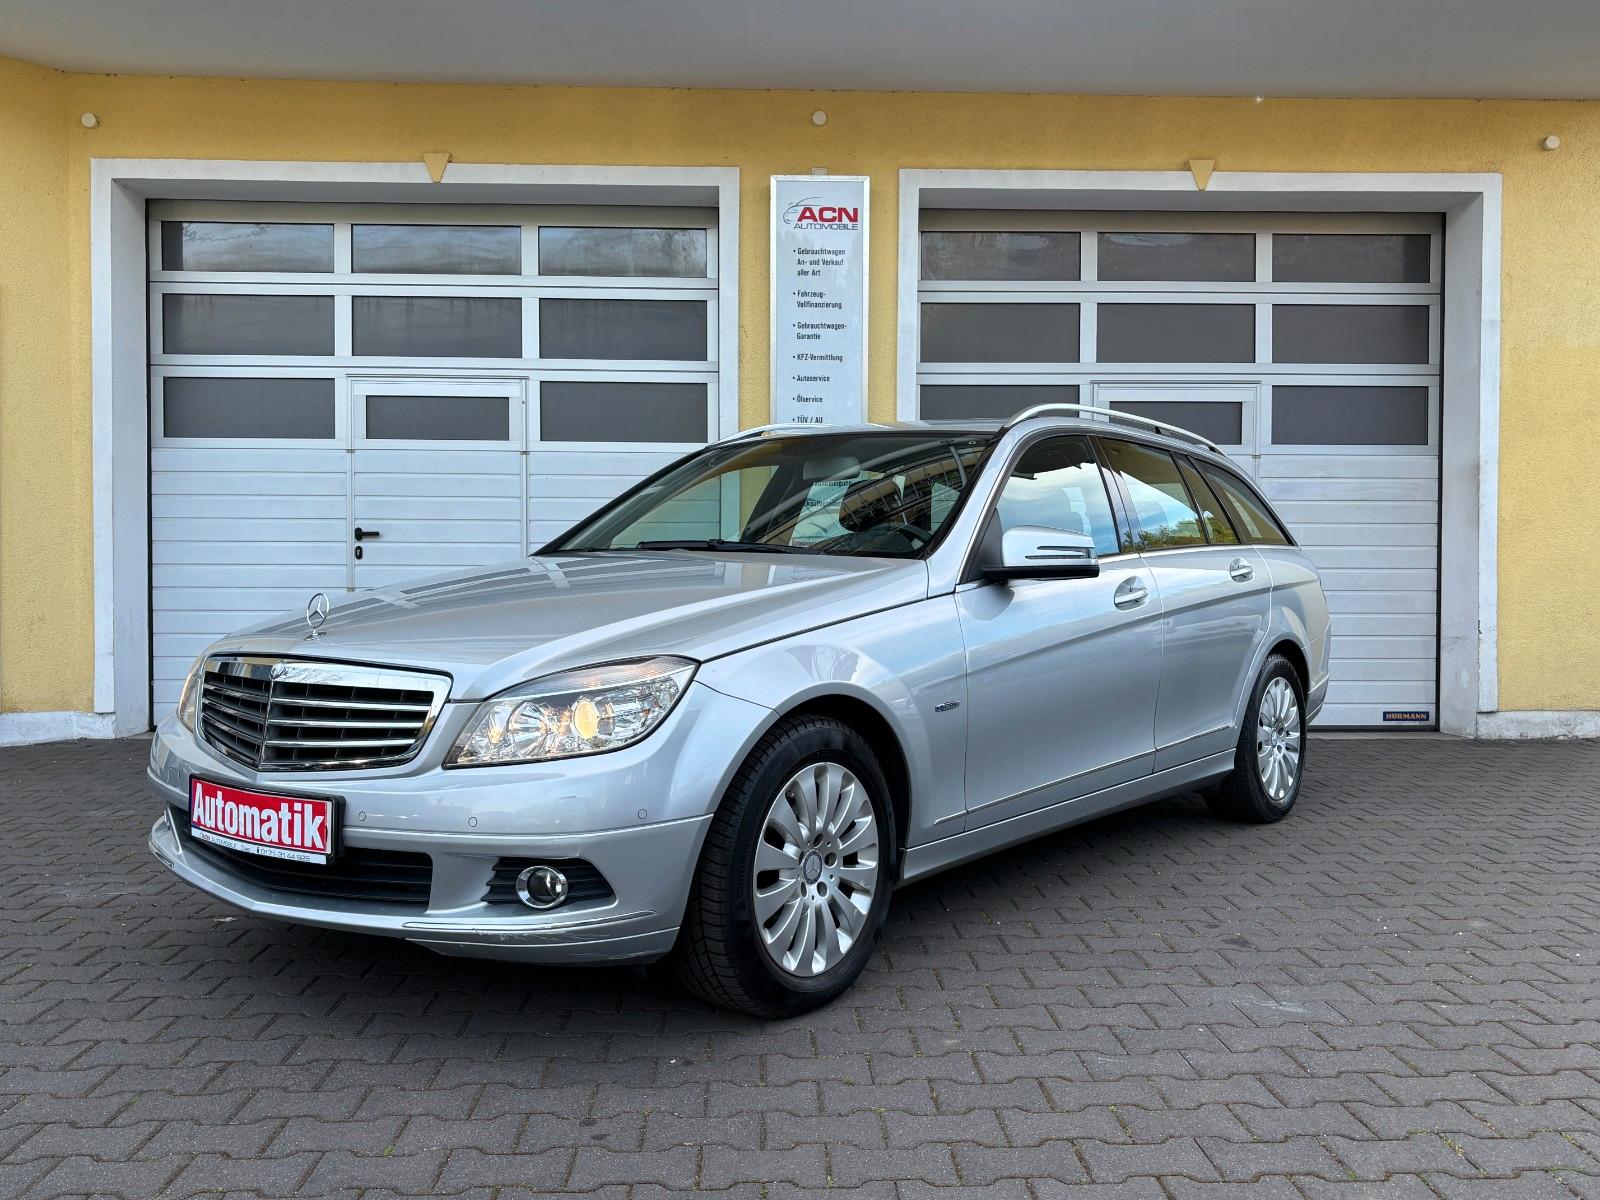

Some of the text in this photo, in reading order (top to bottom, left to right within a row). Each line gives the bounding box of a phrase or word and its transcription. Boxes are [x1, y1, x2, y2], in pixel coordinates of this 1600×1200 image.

[797, 207, 858, 222] ACN
[797, 248, 846, 256] Gebrauchtwagen
[797, 290, 826, 298] Fahrzeug-
[797, 300, 842, 309] Vollfinanzierung
[796, 332, 821, 340] Garantie
[797, 353, 843, 362] KFZ-Vermittlung
[797, 374, 830, 382] Autoservice
[796, 394, 823, 402] Ölservice
[797, 415, 808, 423] TÜV
[193, 783, 325, 849] Automatik
